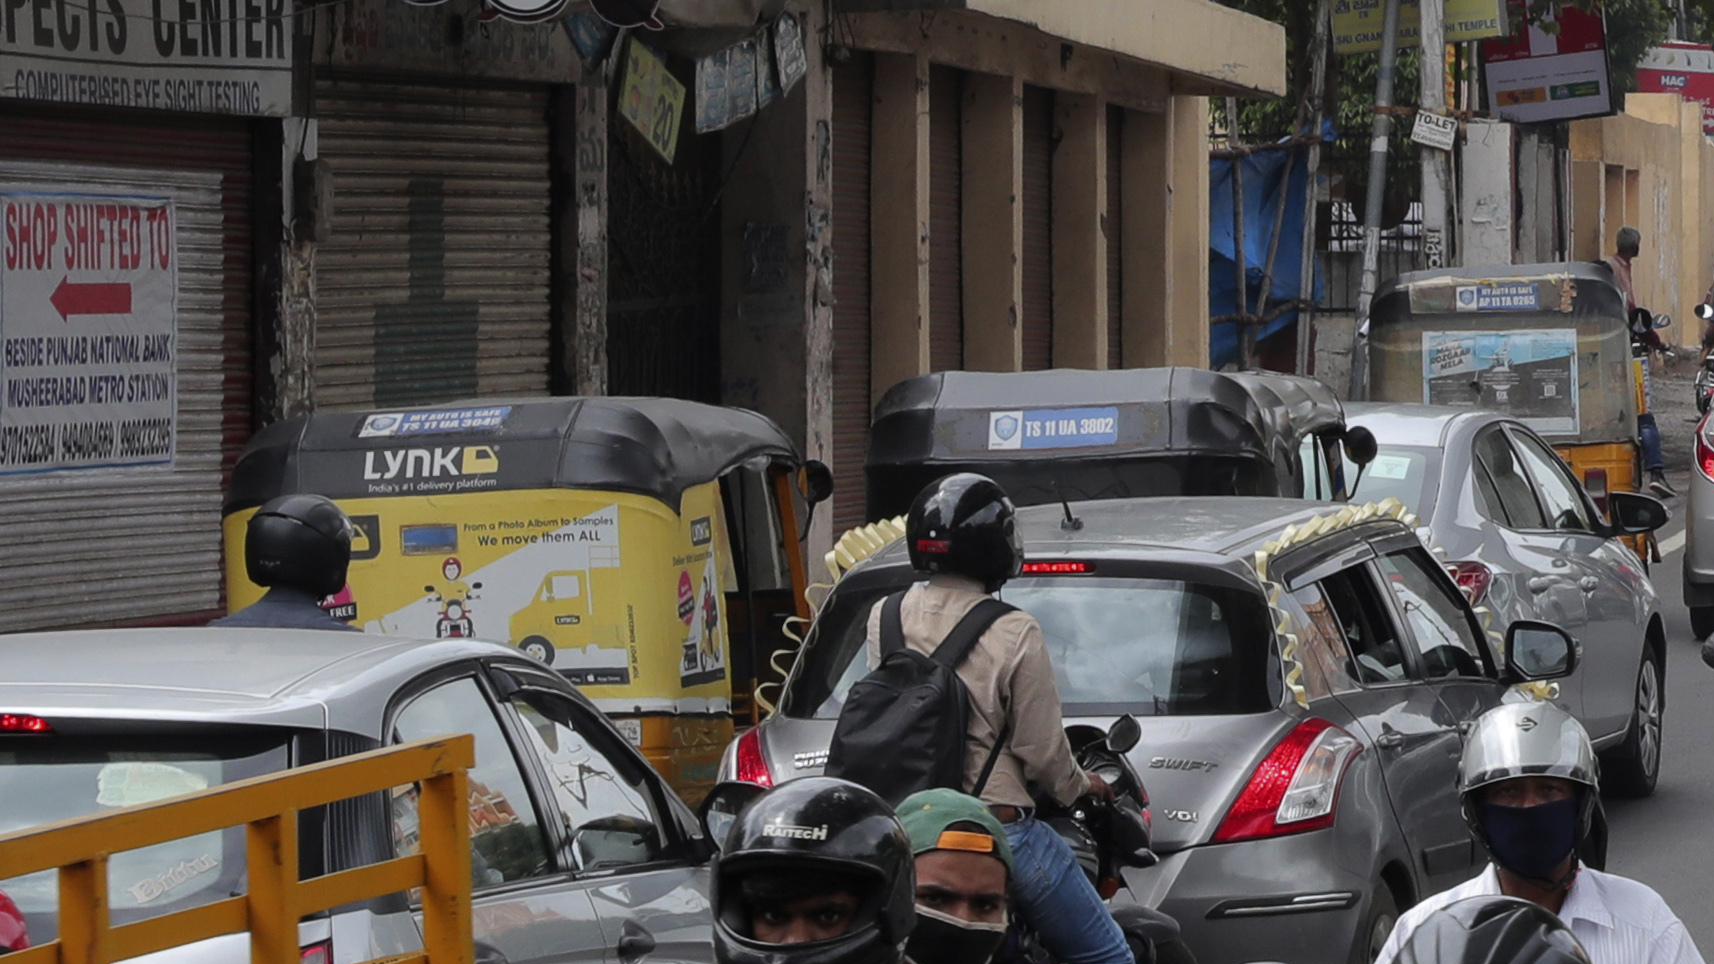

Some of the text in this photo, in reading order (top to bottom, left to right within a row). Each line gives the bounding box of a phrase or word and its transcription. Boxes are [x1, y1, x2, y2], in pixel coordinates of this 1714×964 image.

[152, 0, 287, 59] CENTER
[1336, 35, 1352, 45] SRI
[1458, 19, 1497, 31] TEMPLE
[15, 69, 261, 114] COMPUTERISED EYE SIGHT TESTING
[6, 202, 169, 271] SHOP SHIFTED TO
[1479, 298, 1491, 306] AP
[6, 334, 170, 367] BESIDE PUNJAB NATIONAL BANK
[8, 373, 168, 407] MUSHEERABAD METRO STATION
[429, 412, 457, 420] AUTO
[474, 409, 501, 417] SAFE
[402, 422, 420, 431] TS
[439, 419, 459, 428] UA
[1025, 417, 1114, 437] TS 11 UA 3802
[369, 483, 399, 493] India's
[417, 479, 455, 492] delivery
[456, 478, 497, 490] platform
[498, 521, 524, 529] Photo
[527, 519, 558, 527] Album
[561, 518, 570, 526] to
[573, 516, 614, 528] Samples
[478, 531, 601, 546] We move them ALL
[330, 605, 354, 617] FREE
[1148, 757, 1218, 773] SWIFT
[129, 854, 219, 904] Bittu
